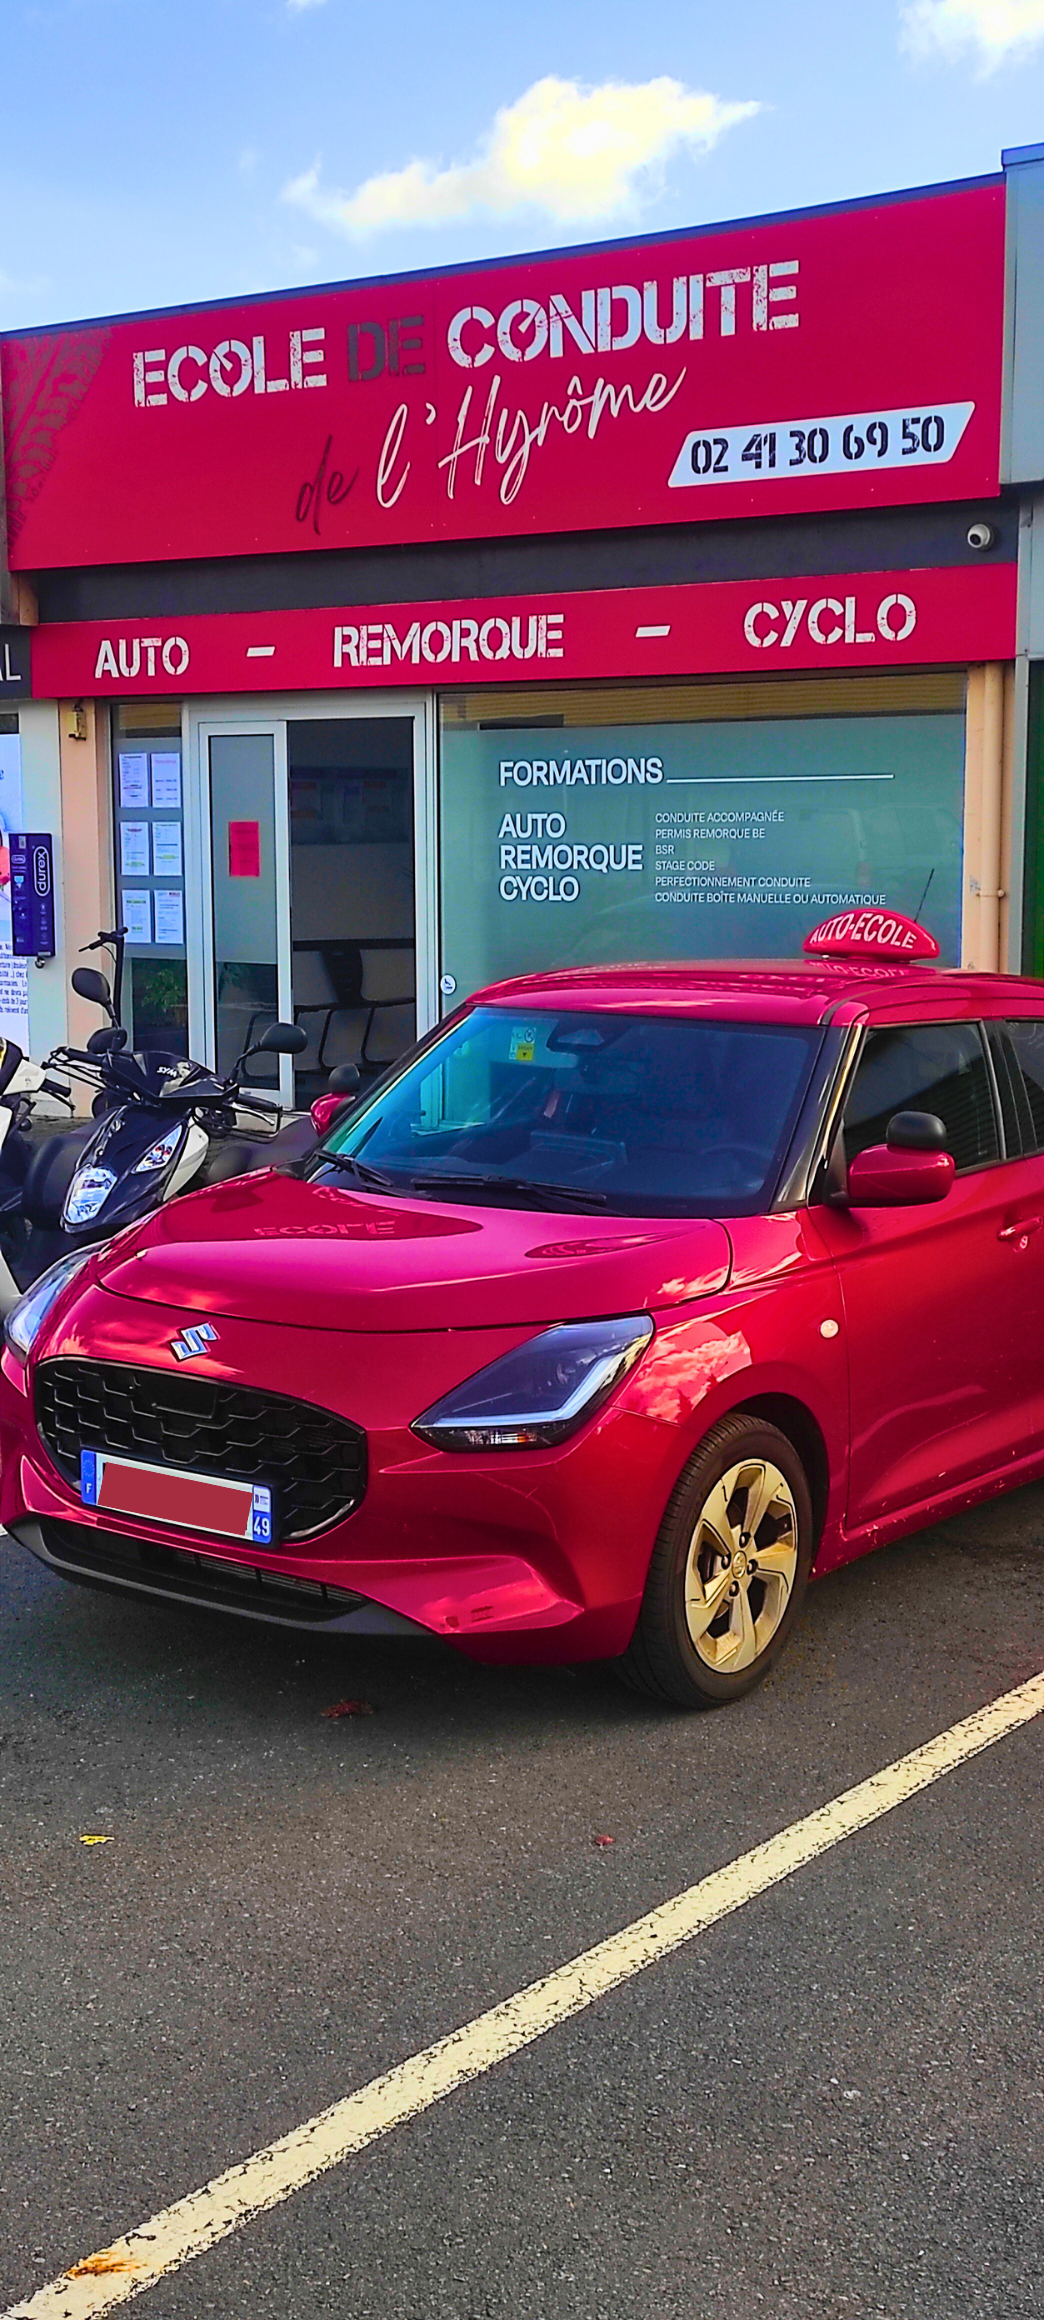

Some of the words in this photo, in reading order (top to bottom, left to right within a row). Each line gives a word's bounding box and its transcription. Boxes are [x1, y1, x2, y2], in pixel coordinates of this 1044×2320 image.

[133, 327, 328, 408] ECOLE
[347, 314, 426, 382] DE
[447, 260, 799, 369] CONDUITE
[691, 438, 729, 475] 02
[741, 432, 776, 470] 41
[789, 427, 829, 467] 30
[842, 421, 889, 460] 69
[901, 415, 945, 456] 50
[295, 434, 360, 536] de
[94, 636, 190, 679] AUTO
[333, 613, 565, 668] REMORQUE
[743, 593, 917, 648] CYCLO
[499, 757, 664, 787] FORMATIONS
[498, 812, 567, 839] AUTO
[655, 812, 705, 823] CONDUITE
[707, 809, 785, 822] ACCOMPAGNÉE
[655, 828, 691, 839] PERMIS
[693, 828, 750, 839] REMORQUE
[752, 828, 766, 839] BE
[500, 843, 643, 874] REMORQUE
[655, 844, 675, 855] BSR
[37, 850, 47, 892] durex
[655, 860, 685, 871] STAGE
[687, 860, 715, 871] CODE
[499, 875, 580, 902] CYCLO
[655, 876, 756, 887] PERFECTIONNEMENT
[758, 877, 811, 888] CONDUITE
[654, 892, 705, 903] CONDUITE
[706, 890, 735, 903] BOÎTE
[737, 893, 791, 904] MANUELLE
[793, 893, 809, 904] OU
[810, 893, 886, 905] AUTOMATIQUE
[809, 912, 917, 949] AUTO-ECOLE
[156, 1066, 178, 1078] SYM
[86, 1483, 92, 1494] F
[253, 1516, 270, 1537] 49
